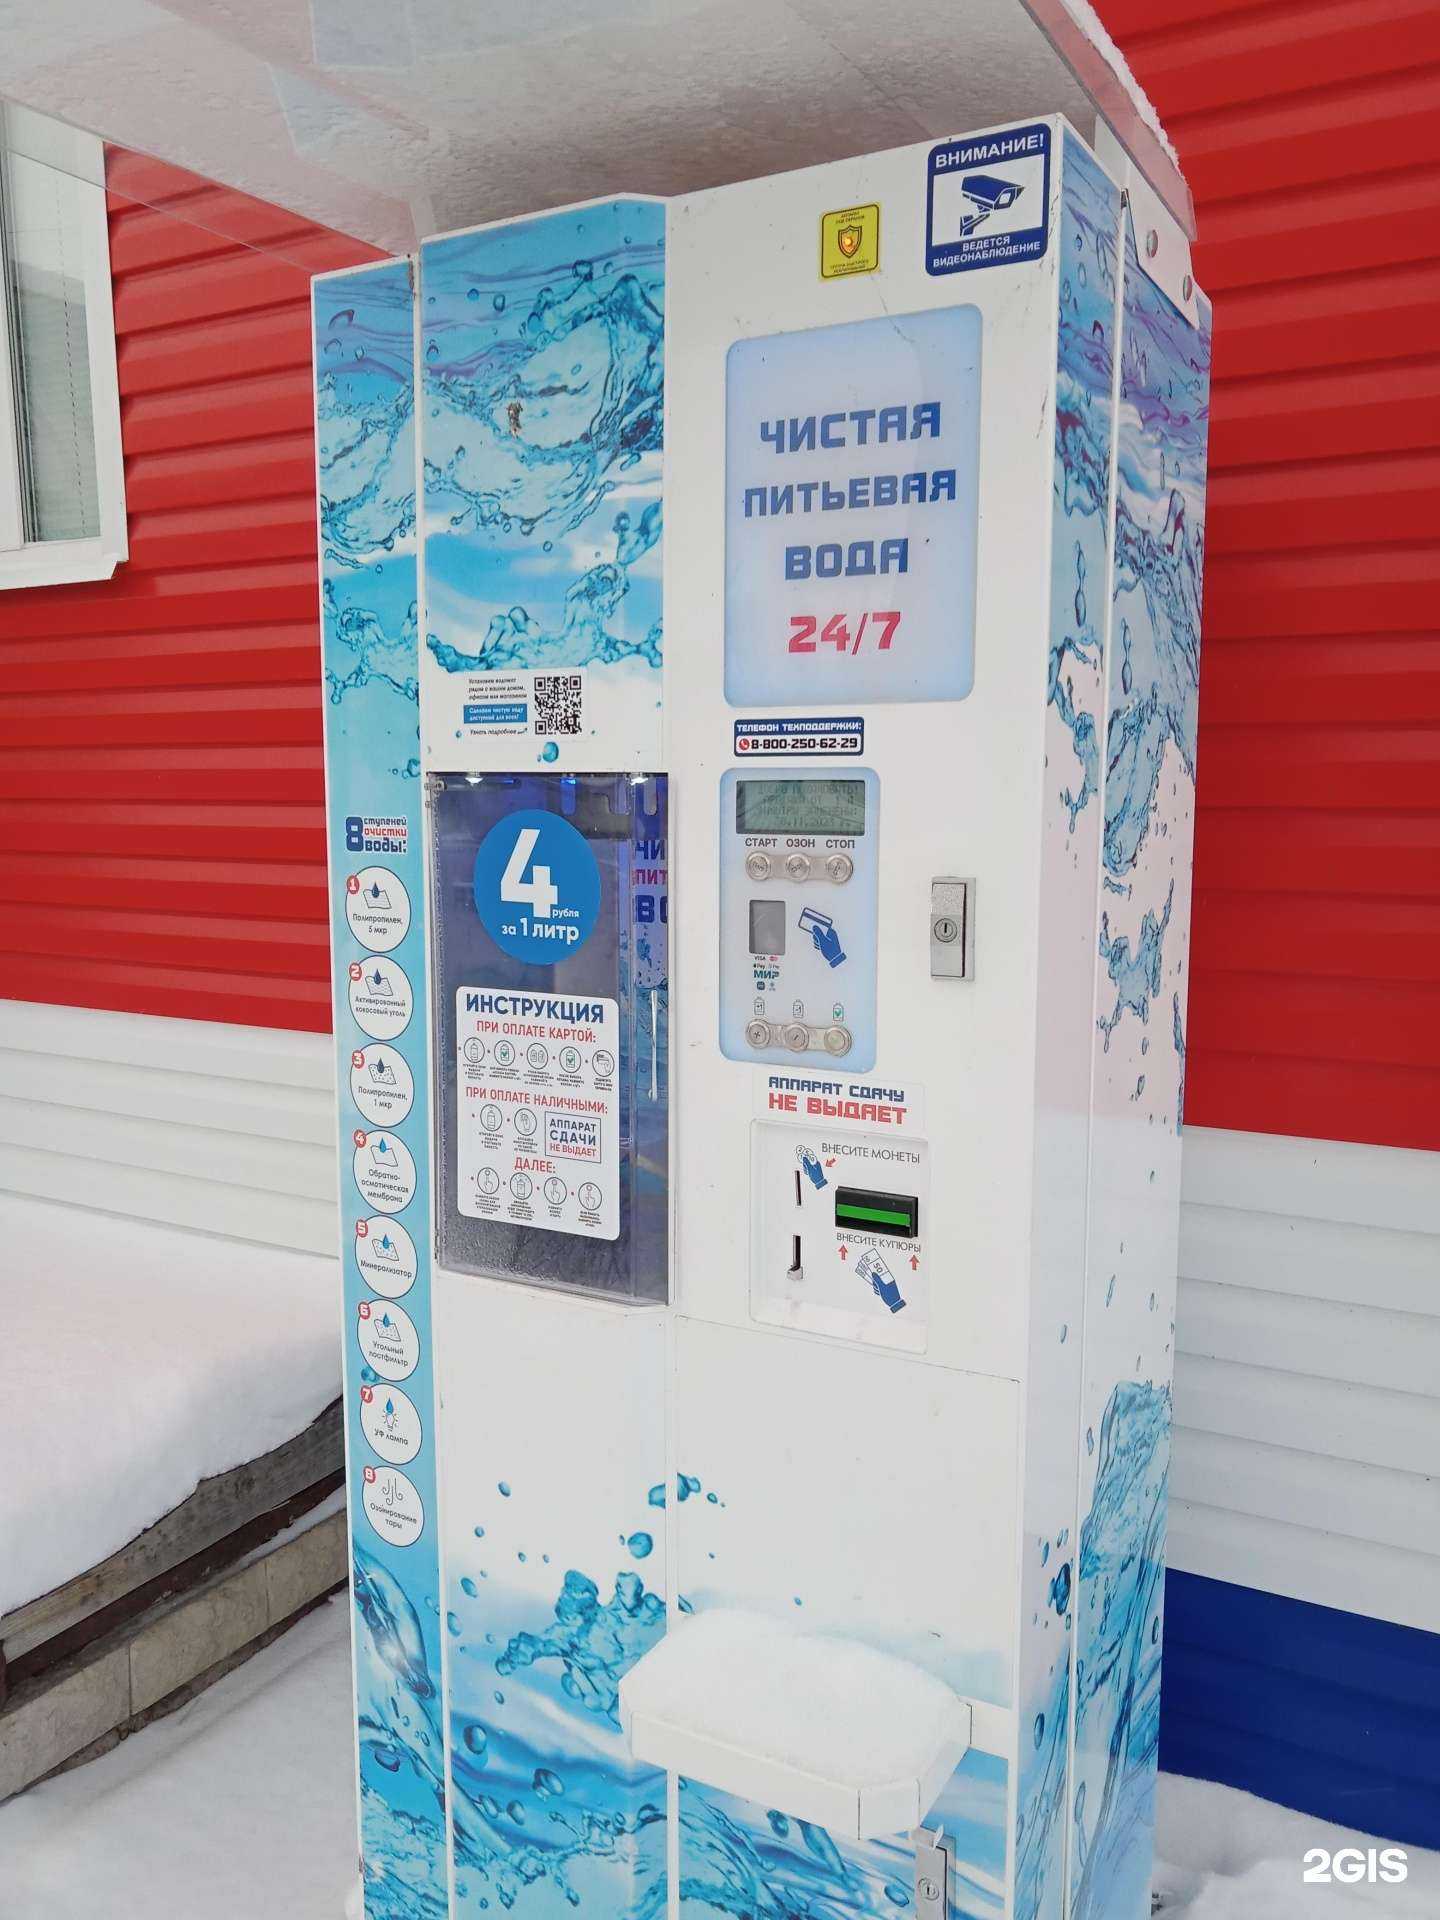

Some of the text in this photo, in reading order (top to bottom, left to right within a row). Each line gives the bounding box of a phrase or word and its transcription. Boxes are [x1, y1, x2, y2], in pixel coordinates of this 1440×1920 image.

[935, 133, 1044, 168] ВНИМАНИЕ!
[962, 235, 1011, 252] ВЕДЕТСЯ
[933, 241, 1041, 267] ВИДЕОНАБЛЮДЕНИЕ
[760, 402, 941, 454] ЧИСТАЯ
[744, 469, 957, 518] ПИТЬЕВАЯ
[785, 538, 909, 581] ВОДА
[787, 611, 902, 656] 24/7
[737, 722, 862, 732] ТЕЛЕФОН ТЕХПОДДЕРЖКИ:
[751, 738, 858, 749] 8-800-250-62-29
[364, 817, 407, 826] ступеней
[346, 816, 364, 852] 8
[364, 827, 407, 837] очистки
[365, 837, 407, 853] воды:
[745, 838, 855, 849] СТАРТ ОЗОН СТОП
[500, 828, 558, 918] 4
[349, 878, 357, 891] 1
[552, 908, 579, 918] рубля
[368, 925, 373, 933] 5
[502, 918, 580, 945] за 1 литр
[351, 963, 360, 978] 2
[753, 970, 780, 979] МИР
[355, 995, 406, 1007] Активированный
[466, 993, 604, 1024] ИНСТРУКЦИЯ
[476, 1020, 597, 1043] ПРИ ОПЛАТЕ КАРТОЙ:
[768, 1076, 904, 1102] АППАРАТ СДАЧУ
[466, 1086, 608, 1114] ПРИ ОПЛАТЕ НАЛИЧНЫМИ:
[768, 1093, 907, 1125] НЕ ВЫДАЕТ
[549, 1118, 597, 1133] АППАРАТ
[356, 1131, 365, 1146] 4
[549, 1130, 597, 1146] СДАЧИ
[550, 1142, 561, 1153] НЕ
[562, 1144, 597, 1157] ВЫДАЕТ
[821, 1142, 869, 1158] ВНЕСИТЕ
[871, 1146, 920, 1163] МОНЕТЫ
[514, 1156, 556, 1174] ДАЛЕЕ:
[836, 1233, 921, 1253] ВНЕСИТЕ КУПЮРЫ
[360, 1260, 412, 1279] Минерализатор
[362, 1388, 370, 1400] 7
[374, 1428, 409, 1446] УФ лампа
